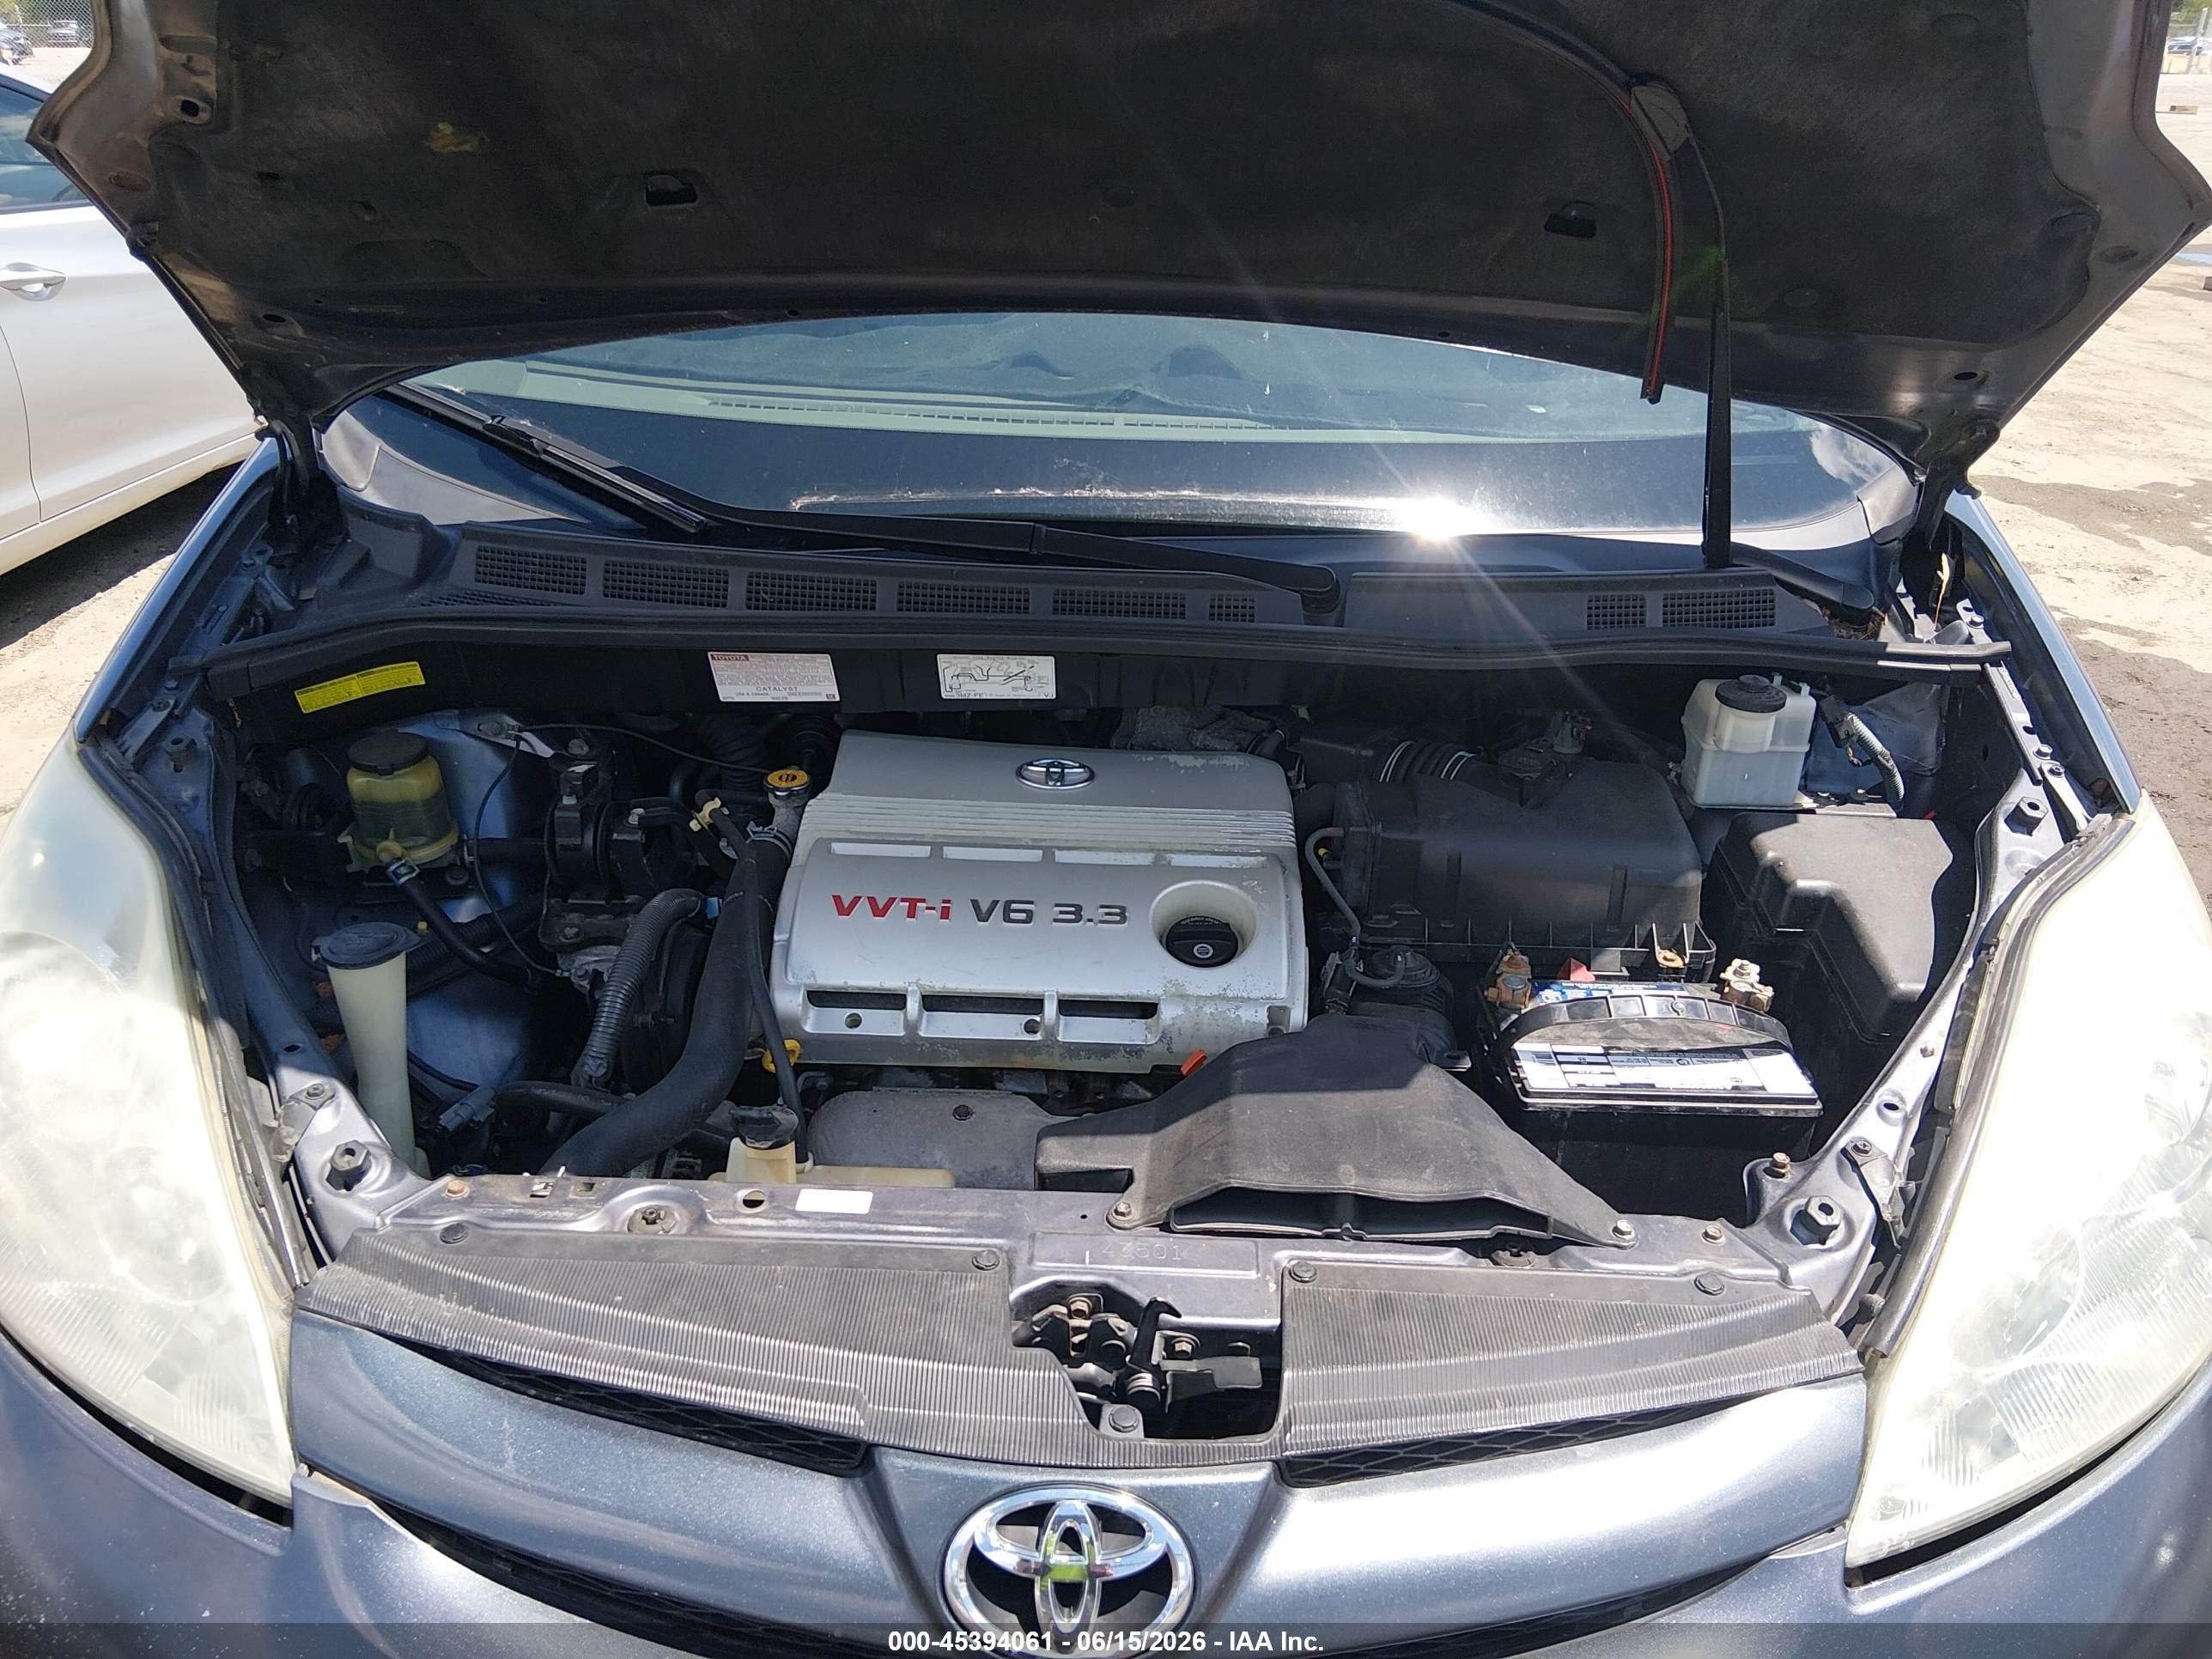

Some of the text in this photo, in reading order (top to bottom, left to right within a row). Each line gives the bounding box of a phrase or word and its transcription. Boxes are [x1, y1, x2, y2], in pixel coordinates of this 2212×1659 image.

[831, 894, 1127, 927] VVT-i V6 3.3
